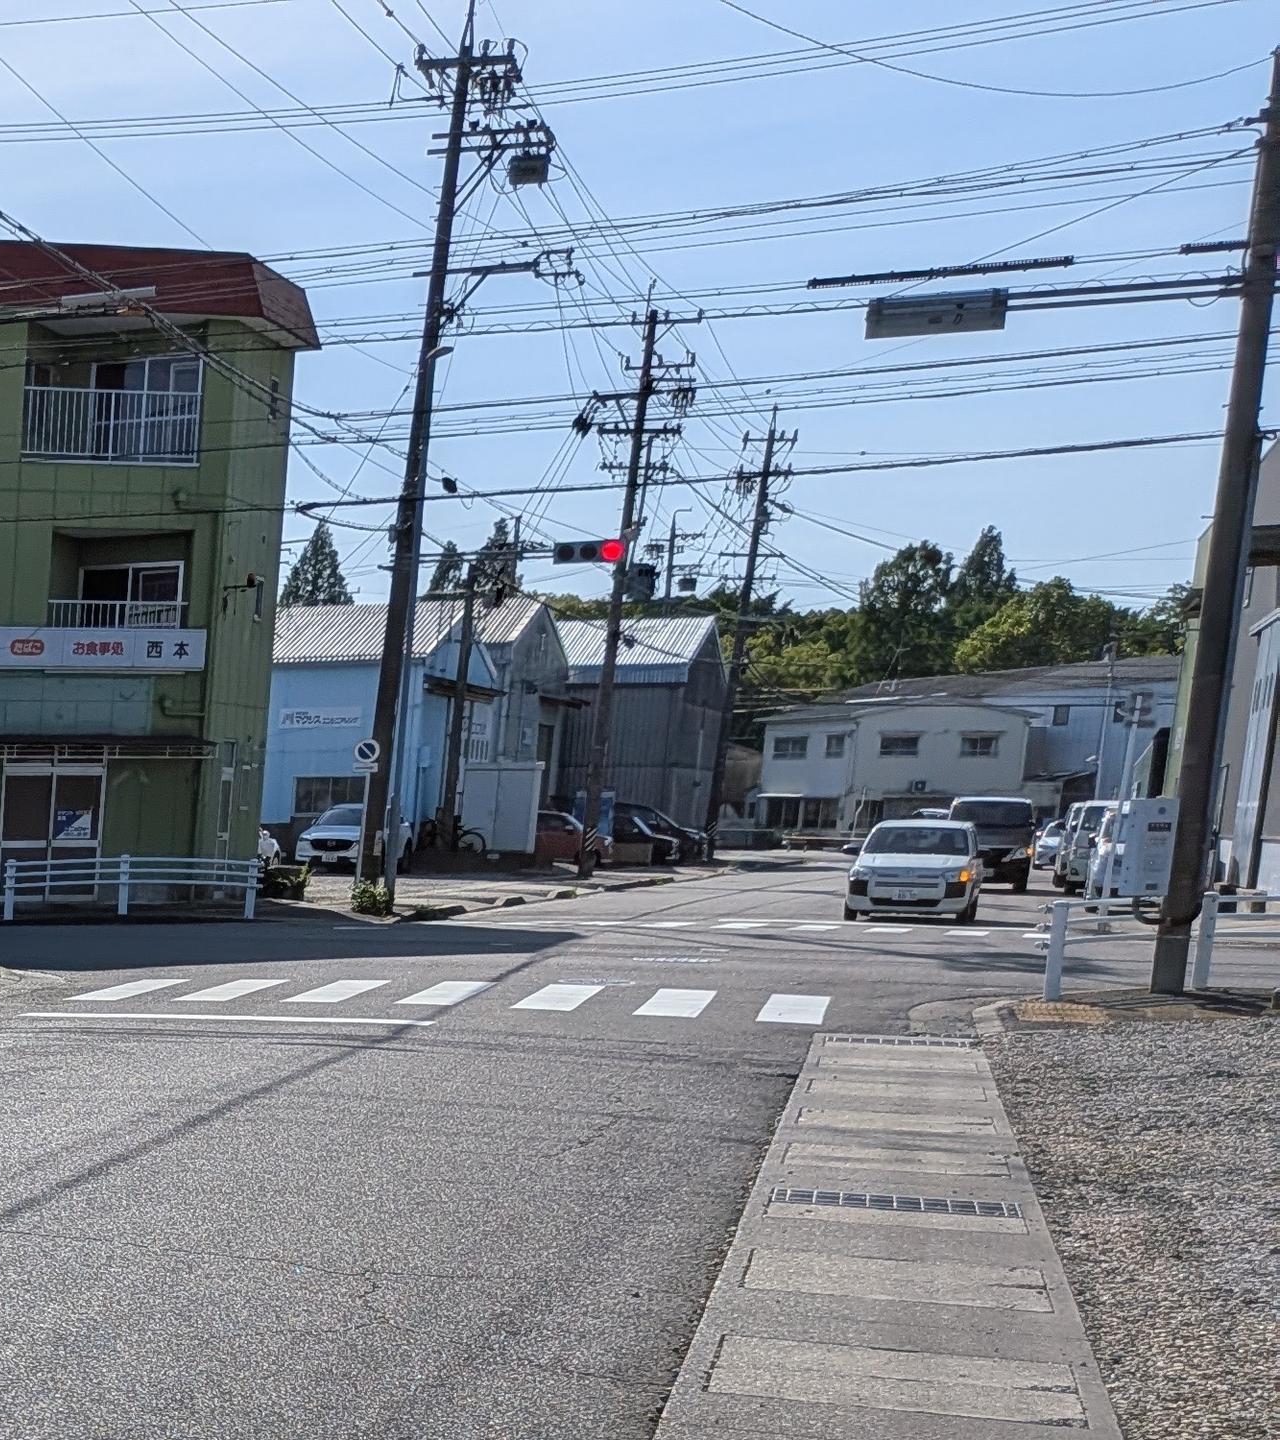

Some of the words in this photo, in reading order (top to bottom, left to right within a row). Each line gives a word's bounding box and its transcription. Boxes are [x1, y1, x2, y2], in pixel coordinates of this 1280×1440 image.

[72, 641, 124, 656] お食事処
[146, 640, 190, 659] 西本
